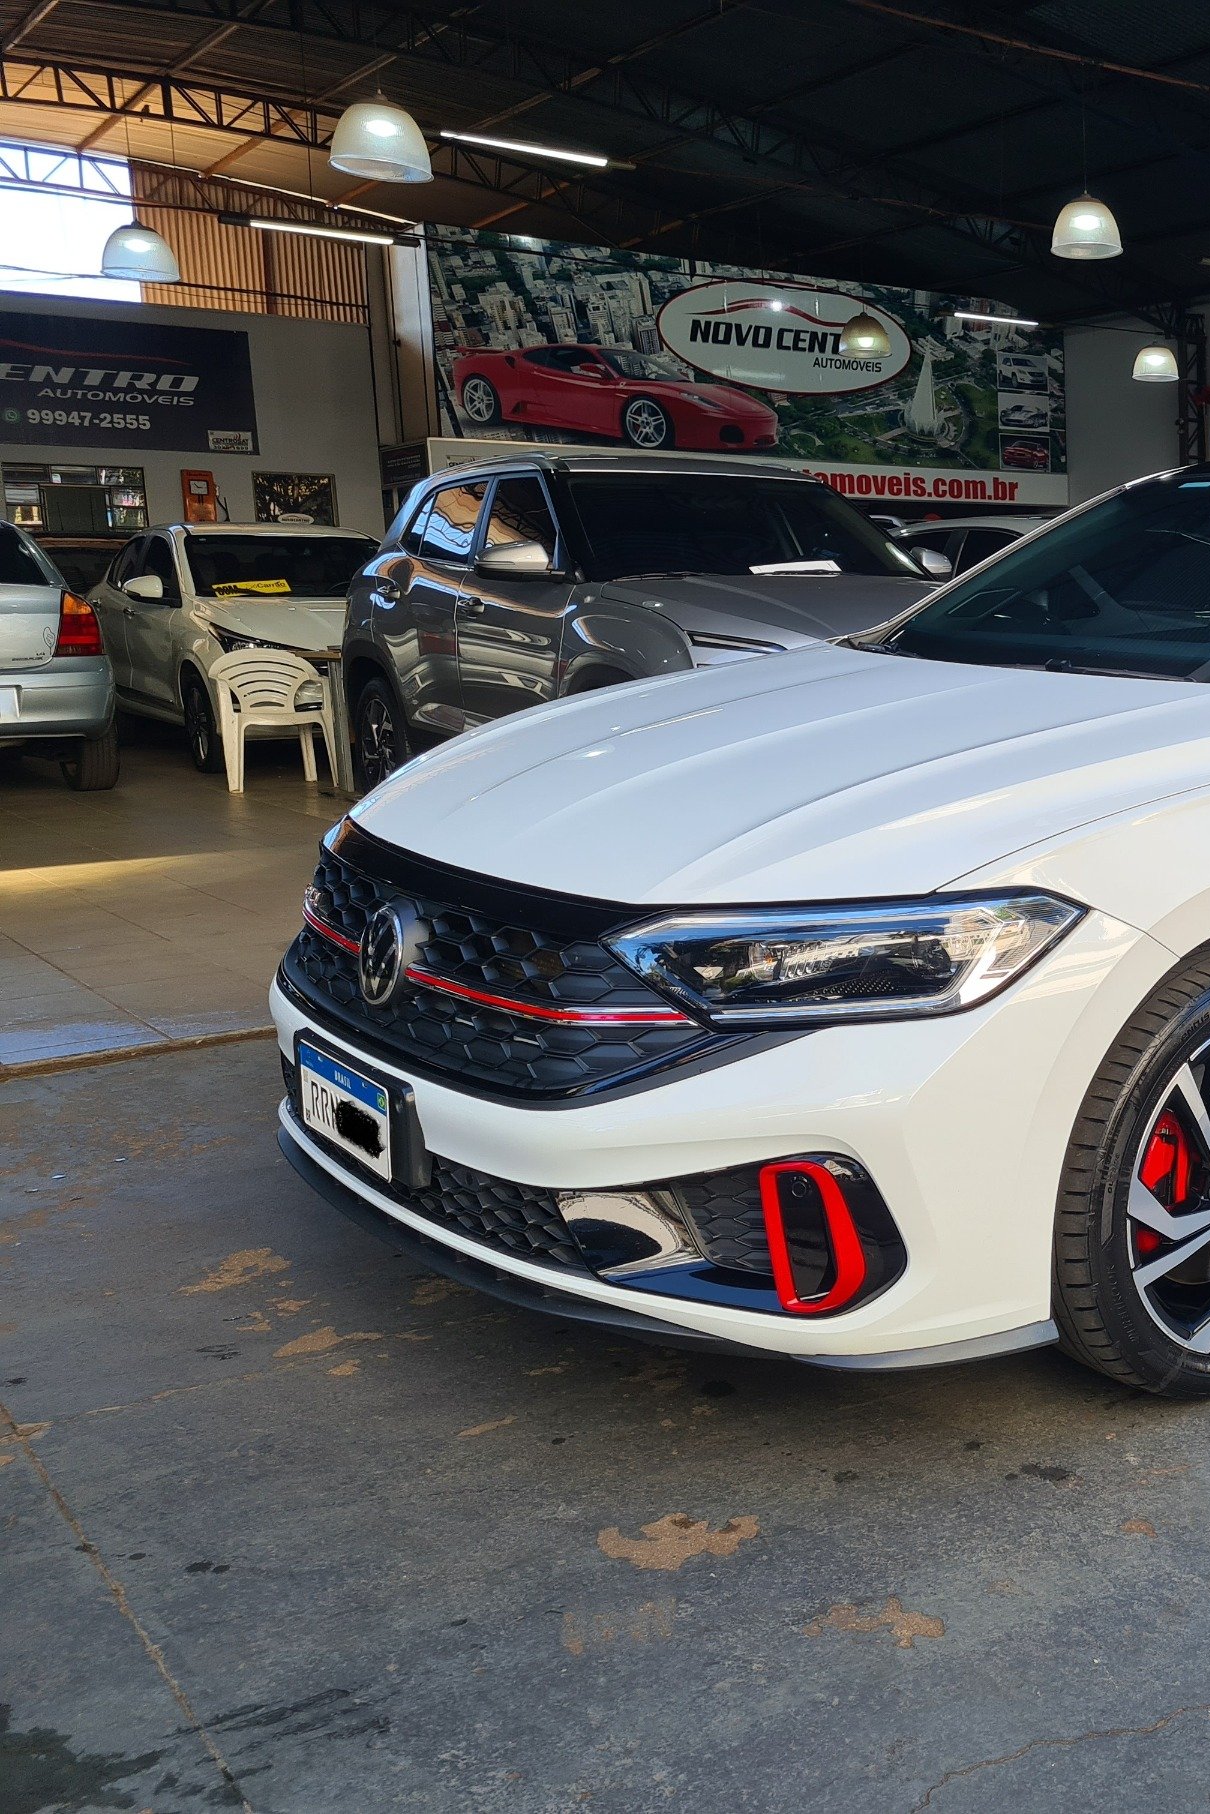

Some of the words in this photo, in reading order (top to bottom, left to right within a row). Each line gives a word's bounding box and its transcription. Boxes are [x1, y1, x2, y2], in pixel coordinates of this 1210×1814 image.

[689, 319, 773, 349] NOVO
[776, 328, 841, 355] CENT
[812, 356, 882, 373] AUTOMÓVEIS
[37, 387, 195, 406] AUTOMÓVEIS
[27, 409, 151, 430] 99947-2555
[334, 1069, 352, 1090] BRASIL
